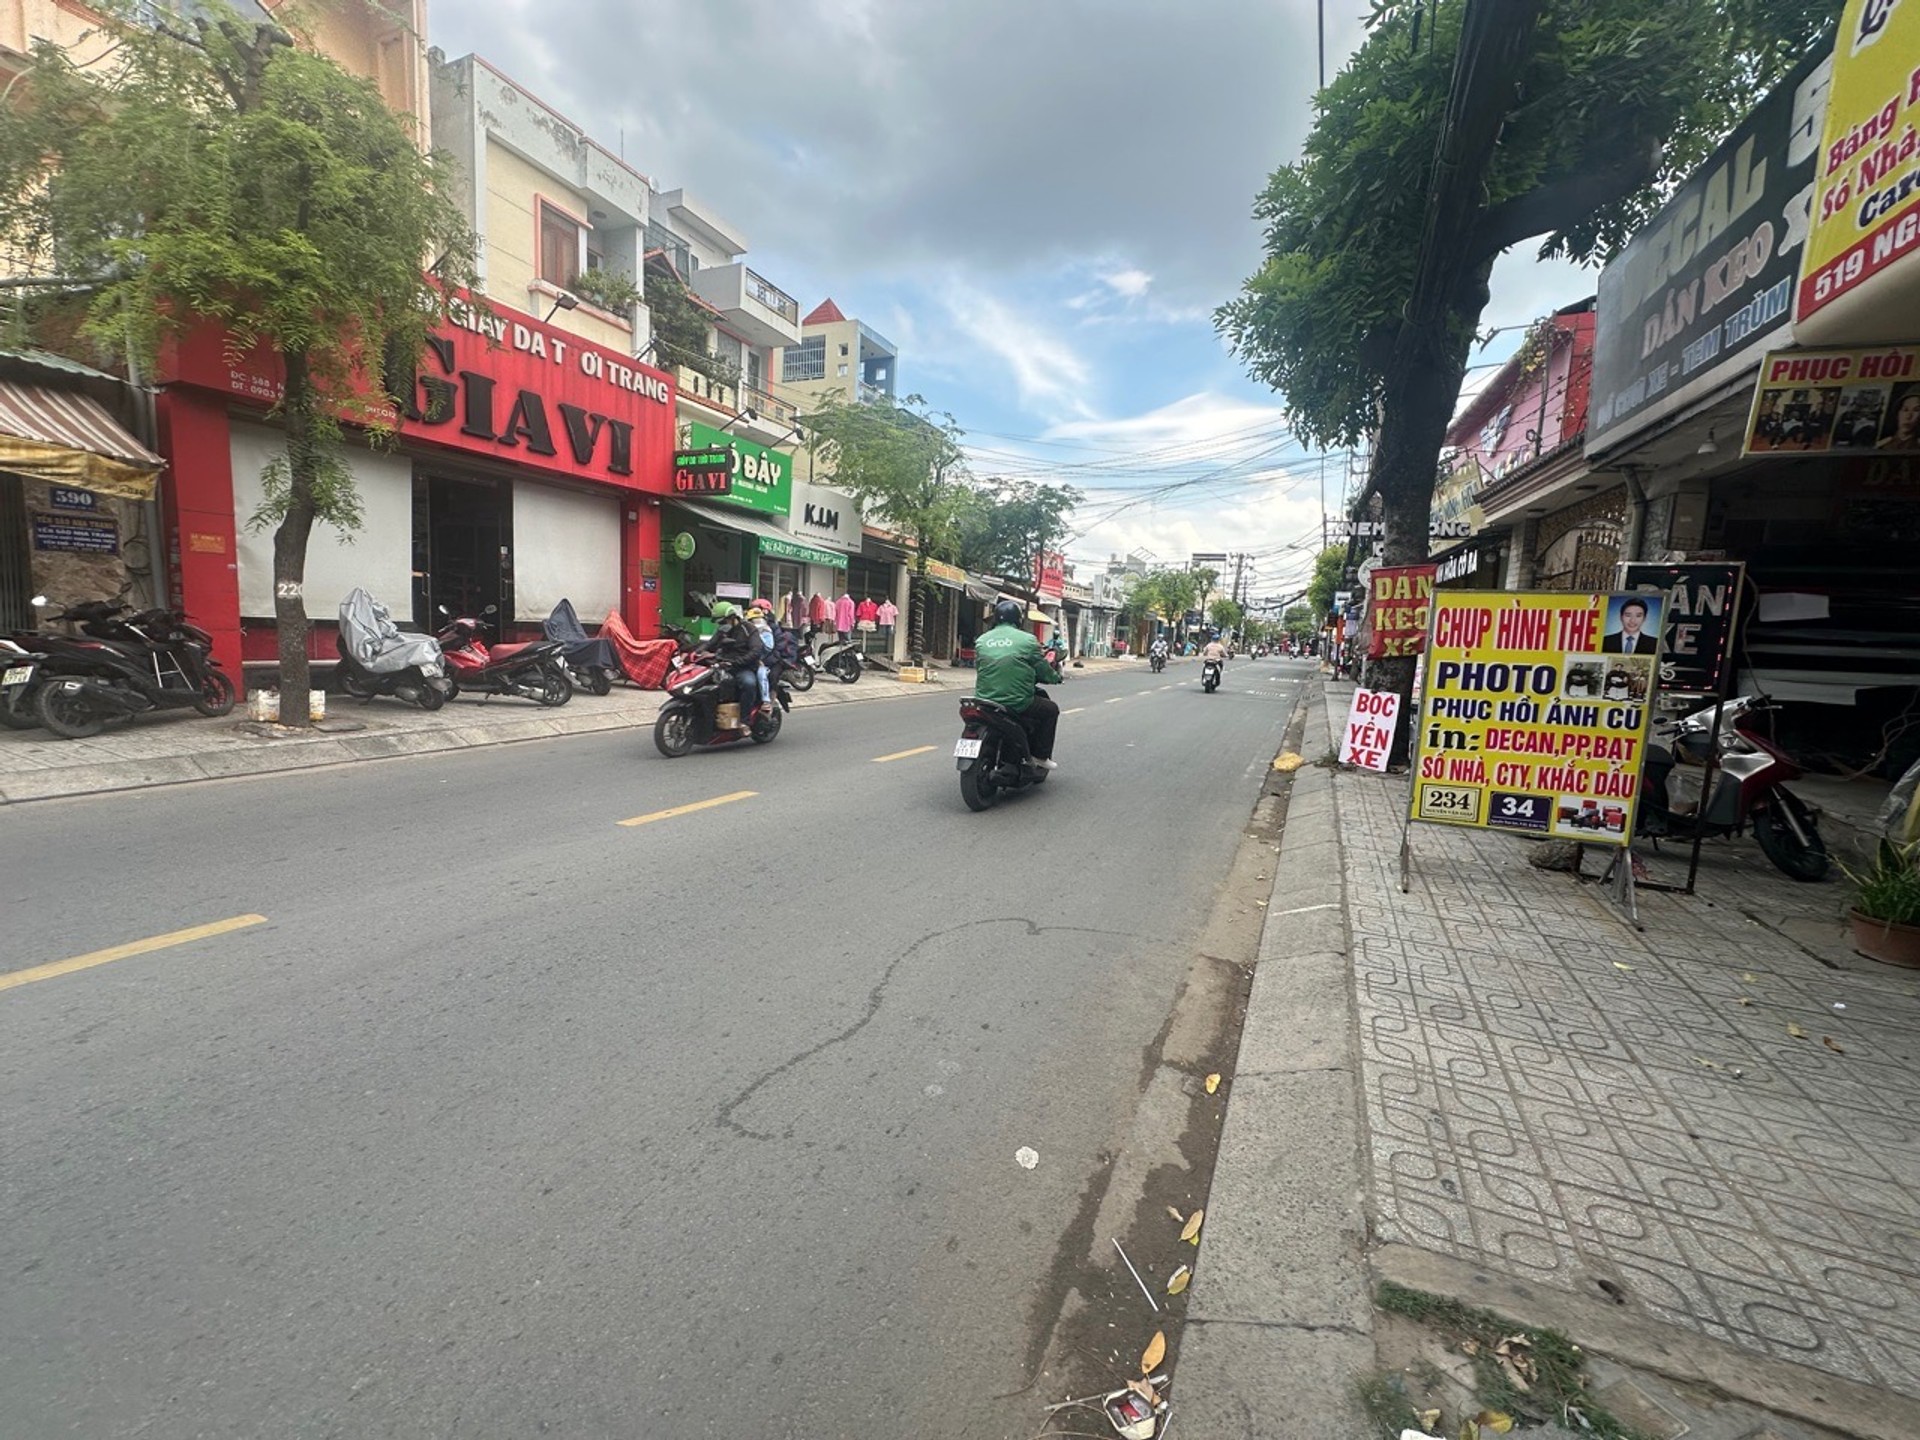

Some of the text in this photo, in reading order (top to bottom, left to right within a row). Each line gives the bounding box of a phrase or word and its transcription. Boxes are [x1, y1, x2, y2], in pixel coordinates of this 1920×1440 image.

[1642, 221, 1775, 358] DÁN KEO
[1814, 249, 1864, 301] 519
[514, 324, 547, 359] DA
[606, 360, 669, 404] TRANG
[1682, 325, 1722, 376] TEM
[1770, 357, 1852, 384] PHỤC
[56, 491, 92, 505] 590
[1375, 569, 1435, 600] DÁN
[1435, 594, 1600, 658] CHỤP HÌNH THẺ
[1436, 662, 1557, 695] PHOTO
[1431, 697, 1493, 724] PHỤC
[1546, 696, 1599, 727] ẢNH
[1606, 704, 1643, 731] CŨ
[1346, 746, 1382, 768] XE
[1421, 751, 1446, 779] SỐ
[1429, 791, 1471, 810] 234
[1501, 797, 1535, 818] 34
